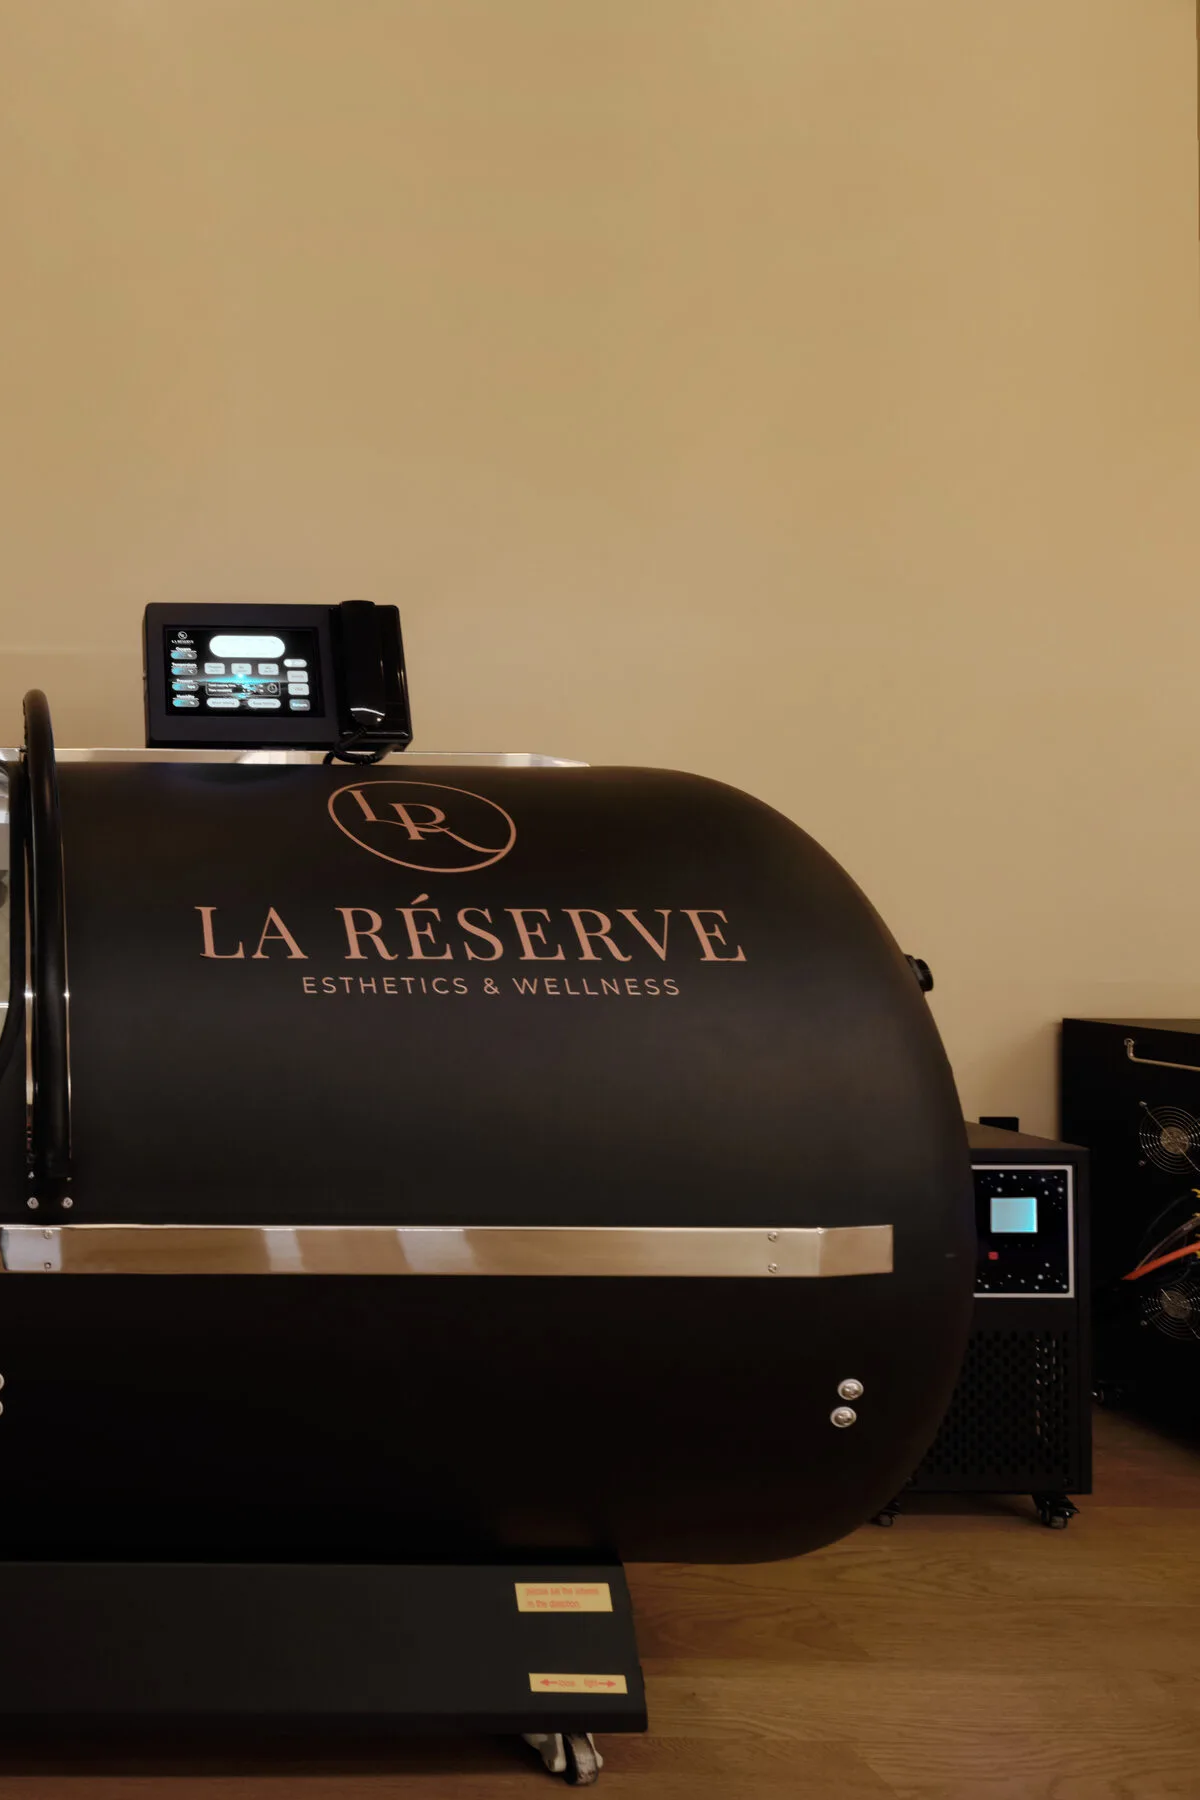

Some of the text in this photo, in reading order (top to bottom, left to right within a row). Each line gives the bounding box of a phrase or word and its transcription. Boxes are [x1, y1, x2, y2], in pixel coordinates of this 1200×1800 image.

[195, 893, 747, 962] LA RÉSERVE
[302, 976, 681, 996] ESTHETICS & WELLNESS
